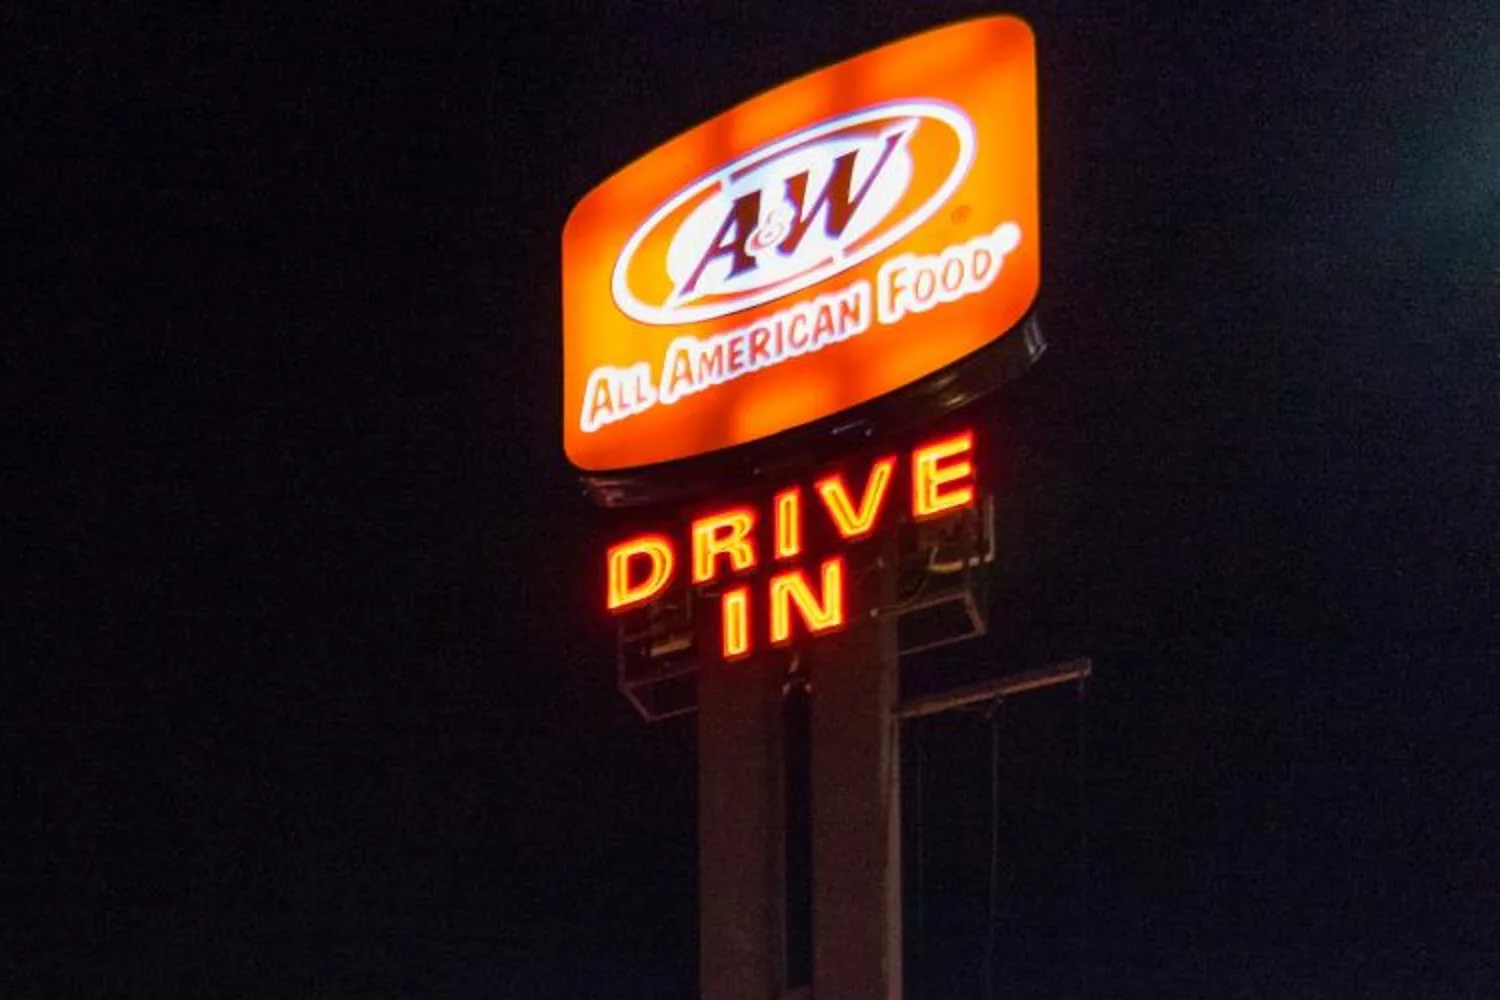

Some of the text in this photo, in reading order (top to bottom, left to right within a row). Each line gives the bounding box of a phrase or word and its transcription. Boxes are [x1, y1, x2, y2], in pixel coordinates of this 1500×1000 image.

[678, 129, 905, 297] A&W
[665, 293, 865, 396] AMERICAN
[885, 247, 994, 314] FOOD
[606, 431, 977, 609] DRIVE
[721, 558, 845, 659] IN
